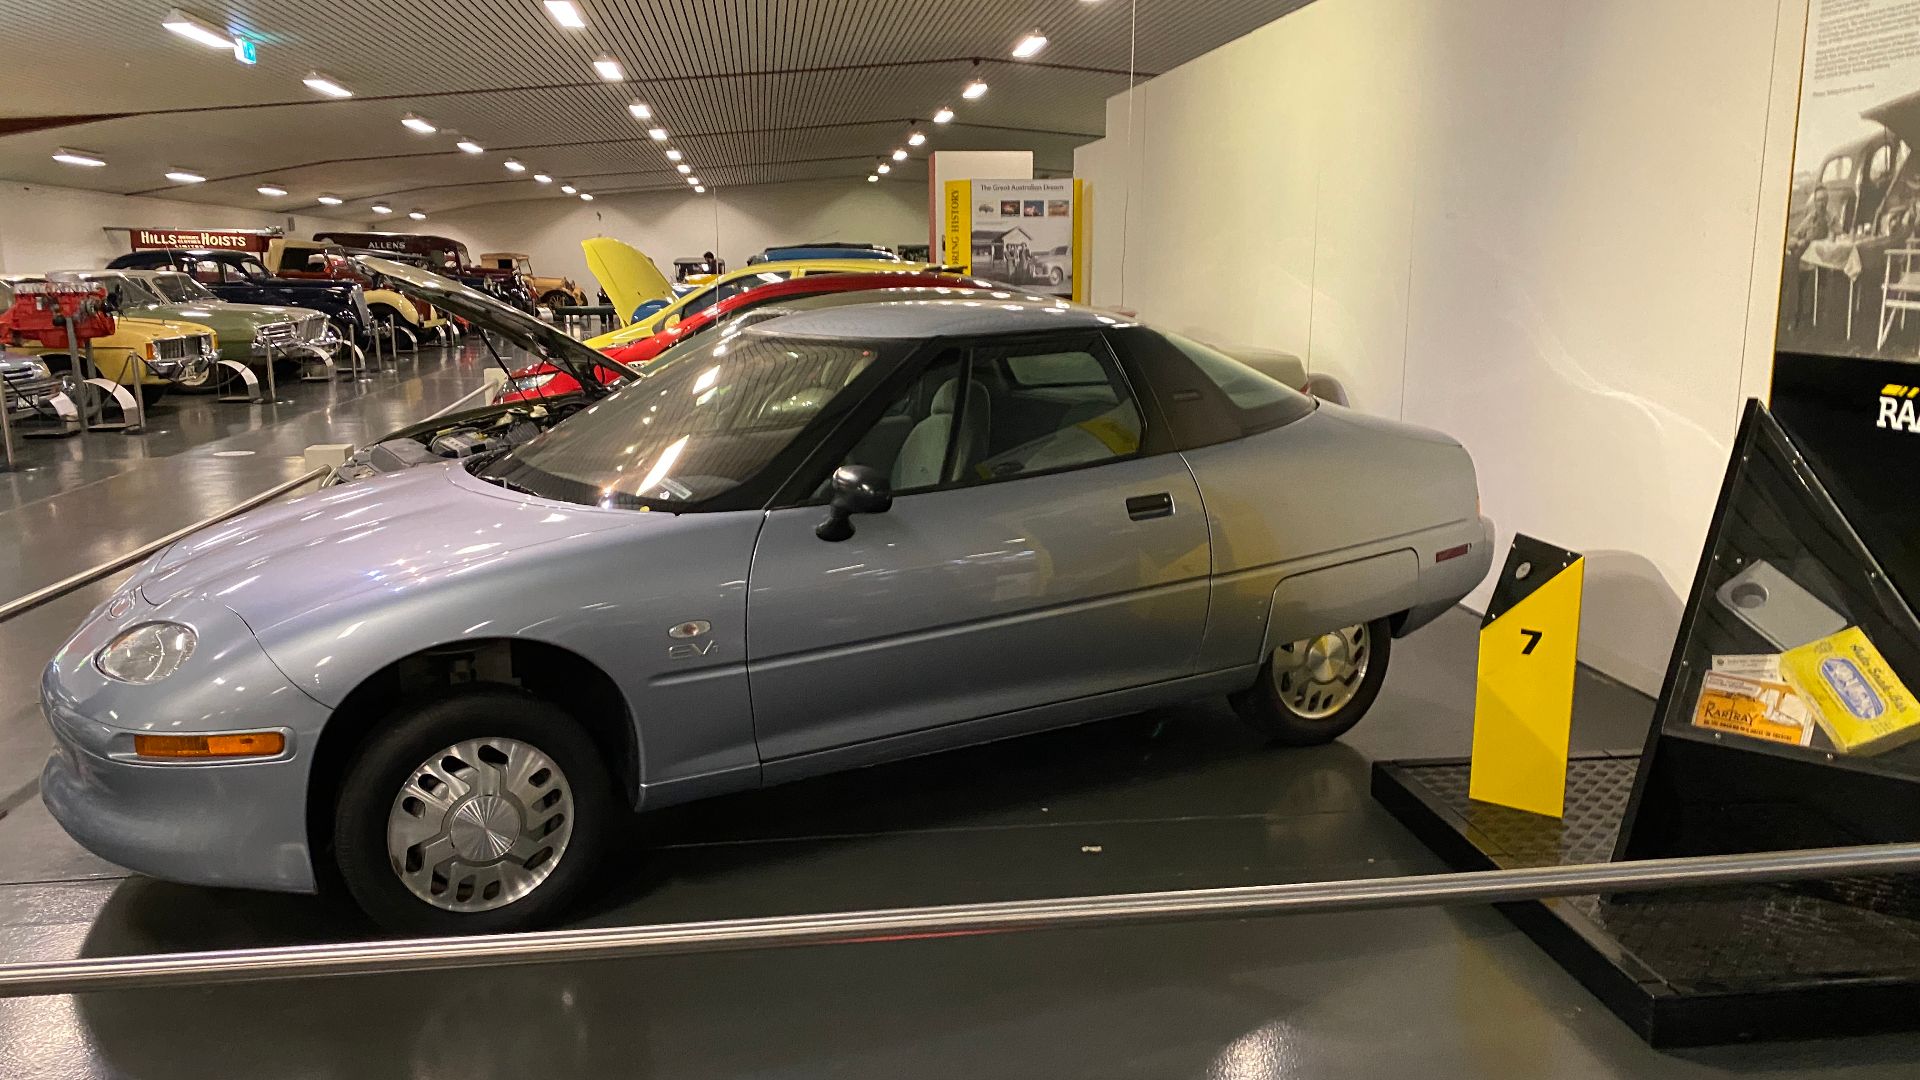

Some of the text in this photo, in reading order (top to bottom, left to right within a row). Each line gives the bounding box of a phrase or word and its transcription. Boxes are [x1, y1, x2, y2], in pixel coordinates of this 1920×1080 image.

[1011, 183, 1042, 191] Australian
[951, 190, 959, 232] HISTORY
[140, 231, 177, 244] HILLS
[201, 232, 246, 246] HOISTS
[1876, 396, 1920, 433] RA
[1520, 628, 1543, 655] 7
